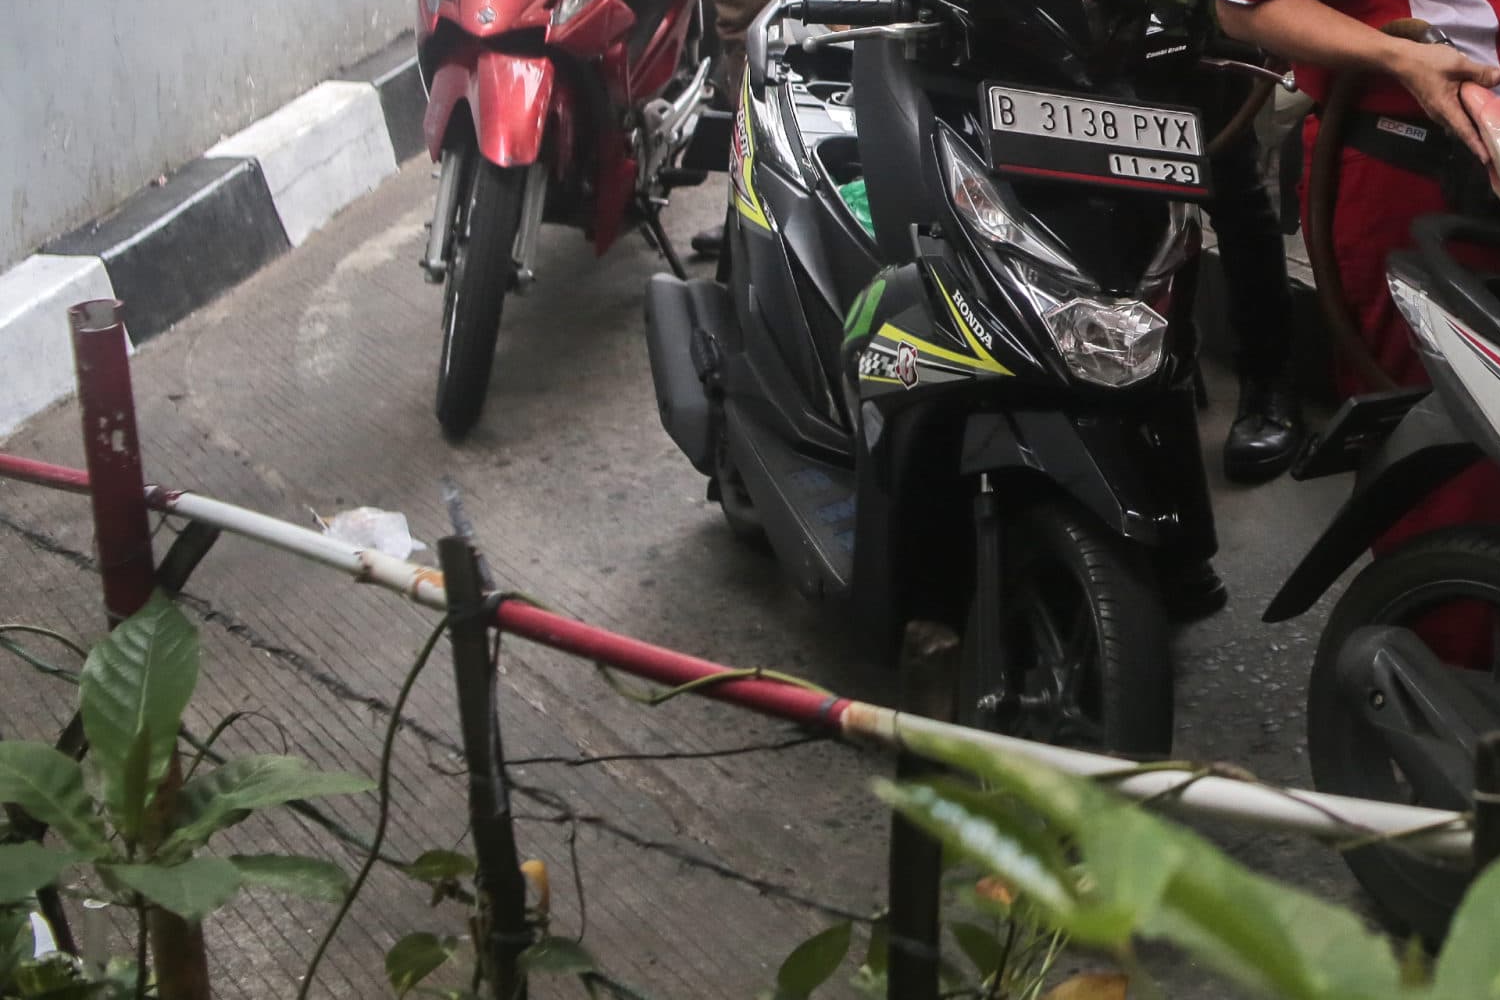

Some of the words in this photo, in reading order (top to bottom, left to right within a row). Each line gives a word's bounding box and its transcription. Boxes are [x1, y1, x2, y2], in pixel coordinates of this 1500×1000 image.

[999, 95, 1015, 126] B
[1041, 102, 1118, 140] 3138
[1134, 114, 1191, 150] PYX
[952, 289, 993, 351] HONDA
